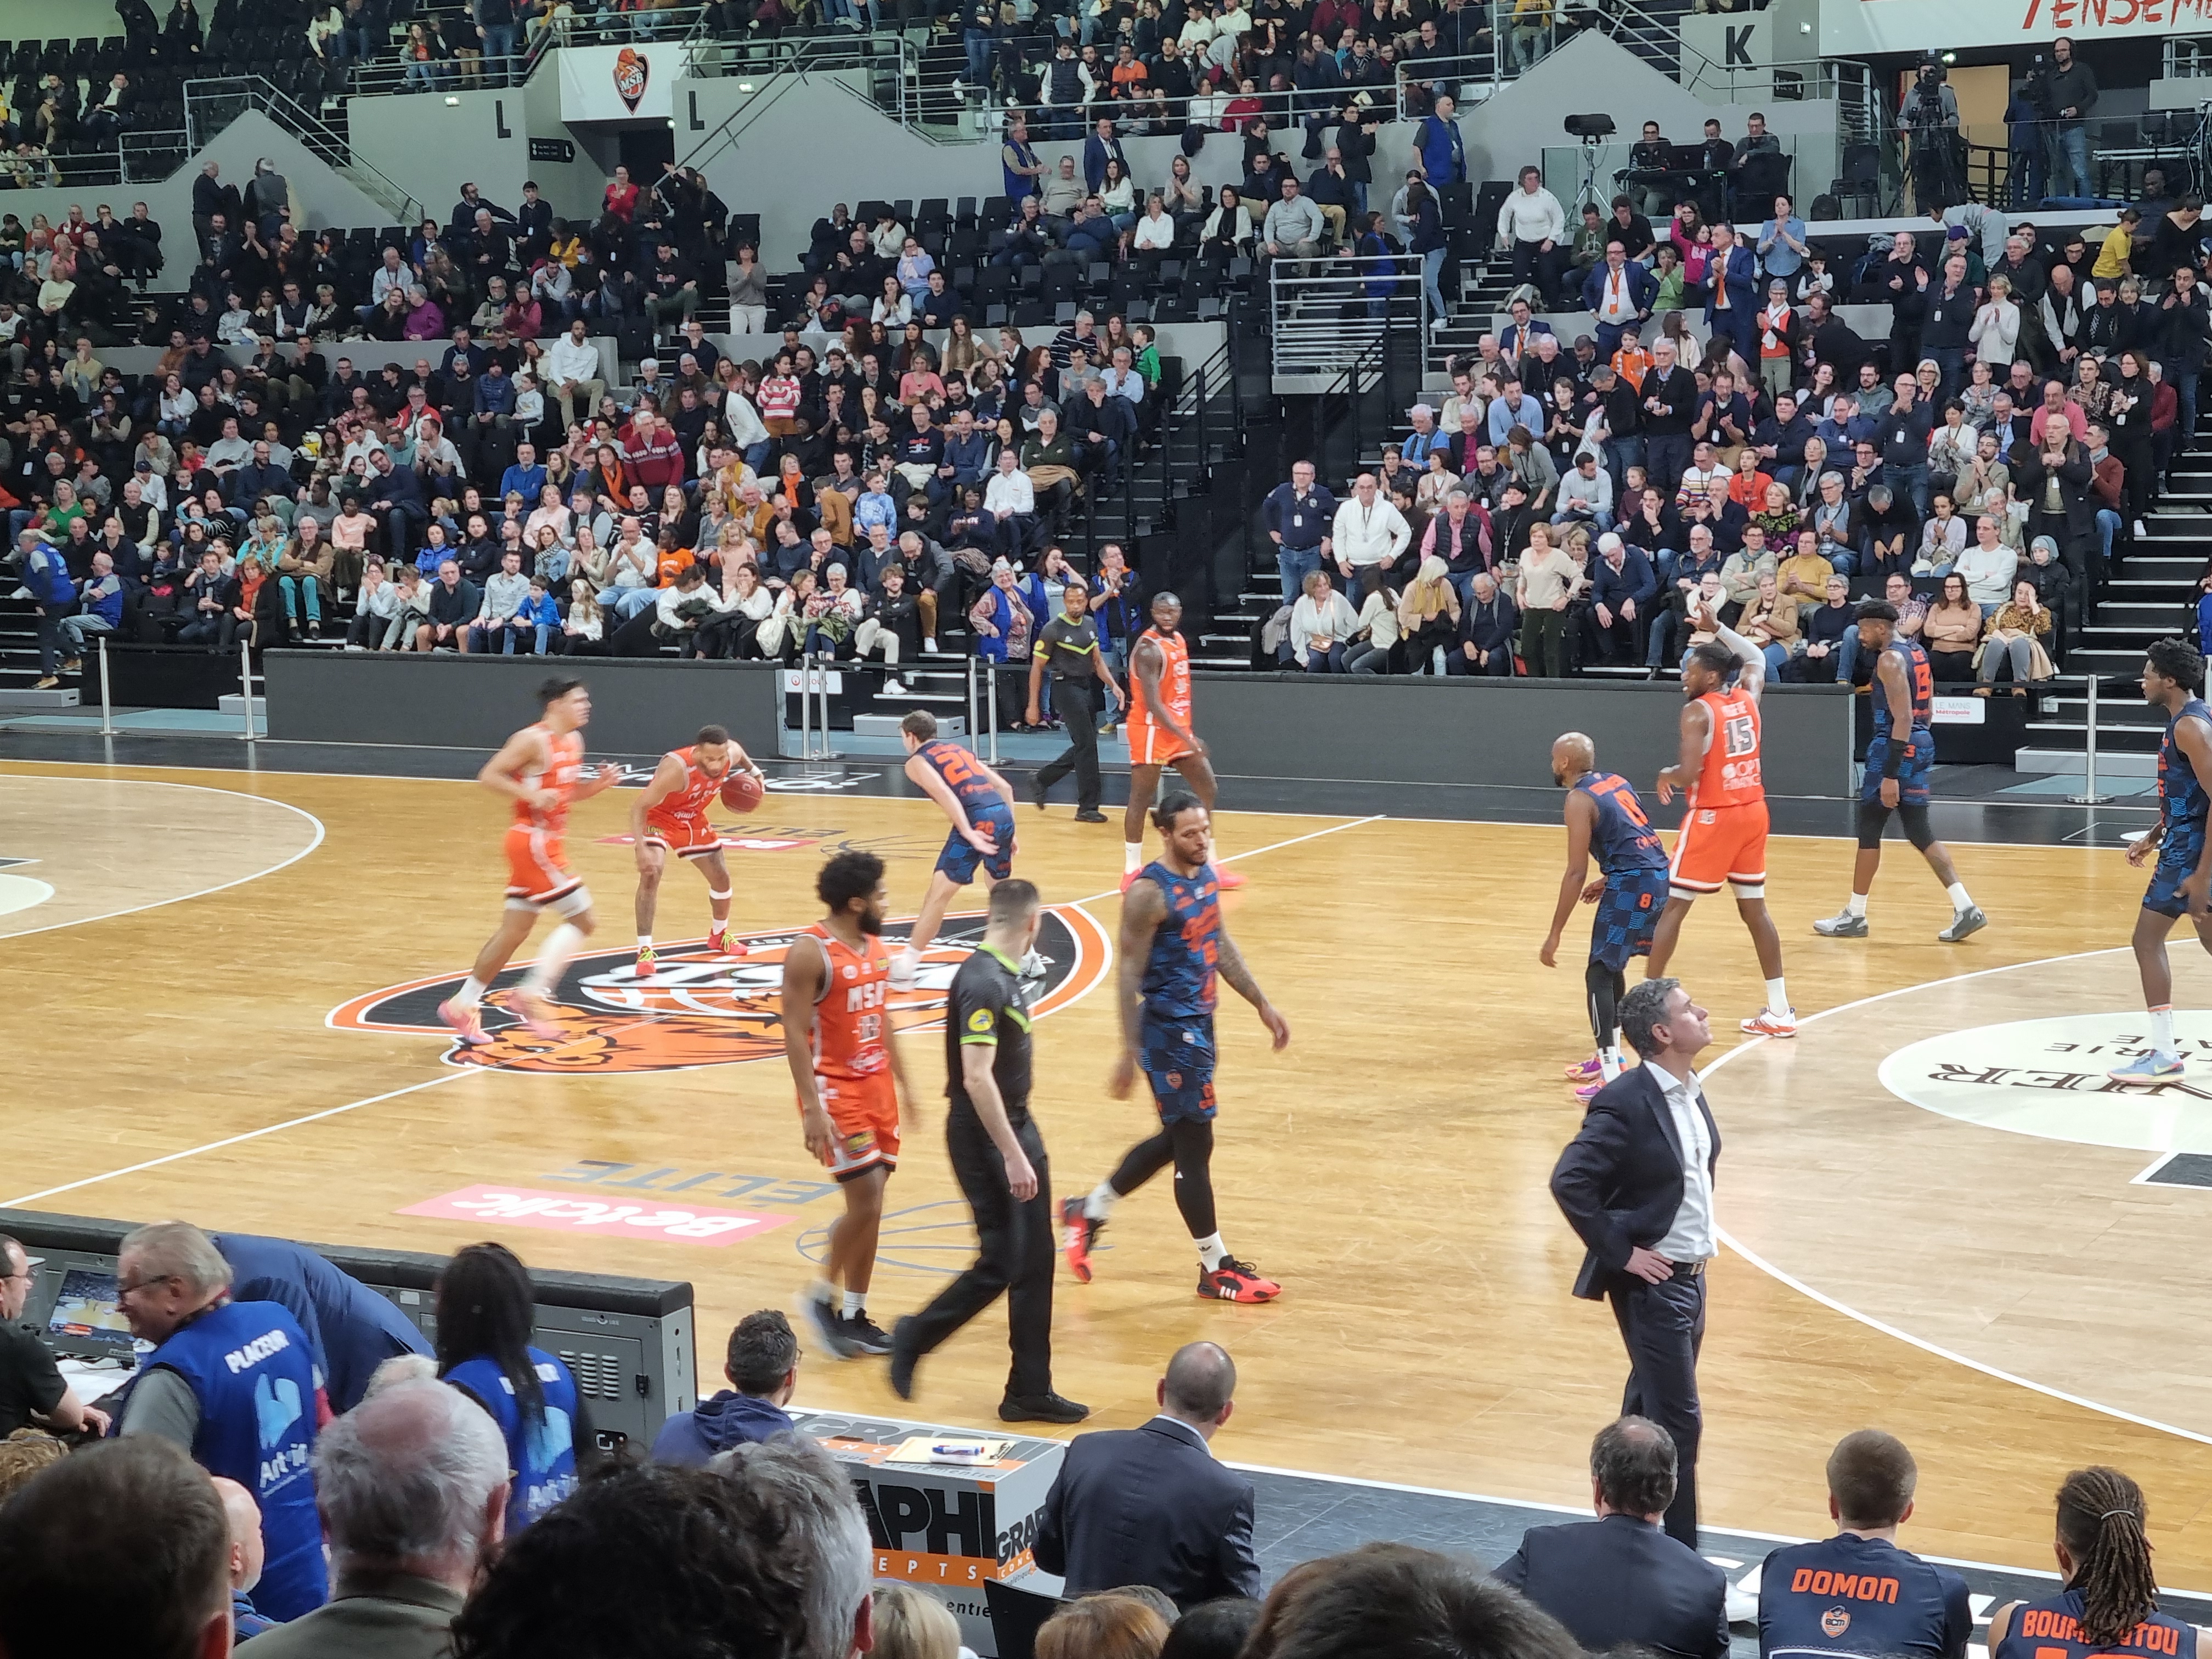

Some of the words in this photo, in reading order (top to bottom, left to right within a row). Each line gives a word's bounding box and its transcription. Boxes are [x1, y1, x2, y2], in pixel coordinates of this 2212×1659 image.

[1726, 25, 1757, 72] K
[620, 73, 644, 91] MSB
[496, 100, 511, 138] L
[689, 91, 704, 130] L
[1723, 715, 1757, 757] 15
[451, 1193, 761, 1238] Betclic
[1791, 1568, 1899, 1604] DOMON
